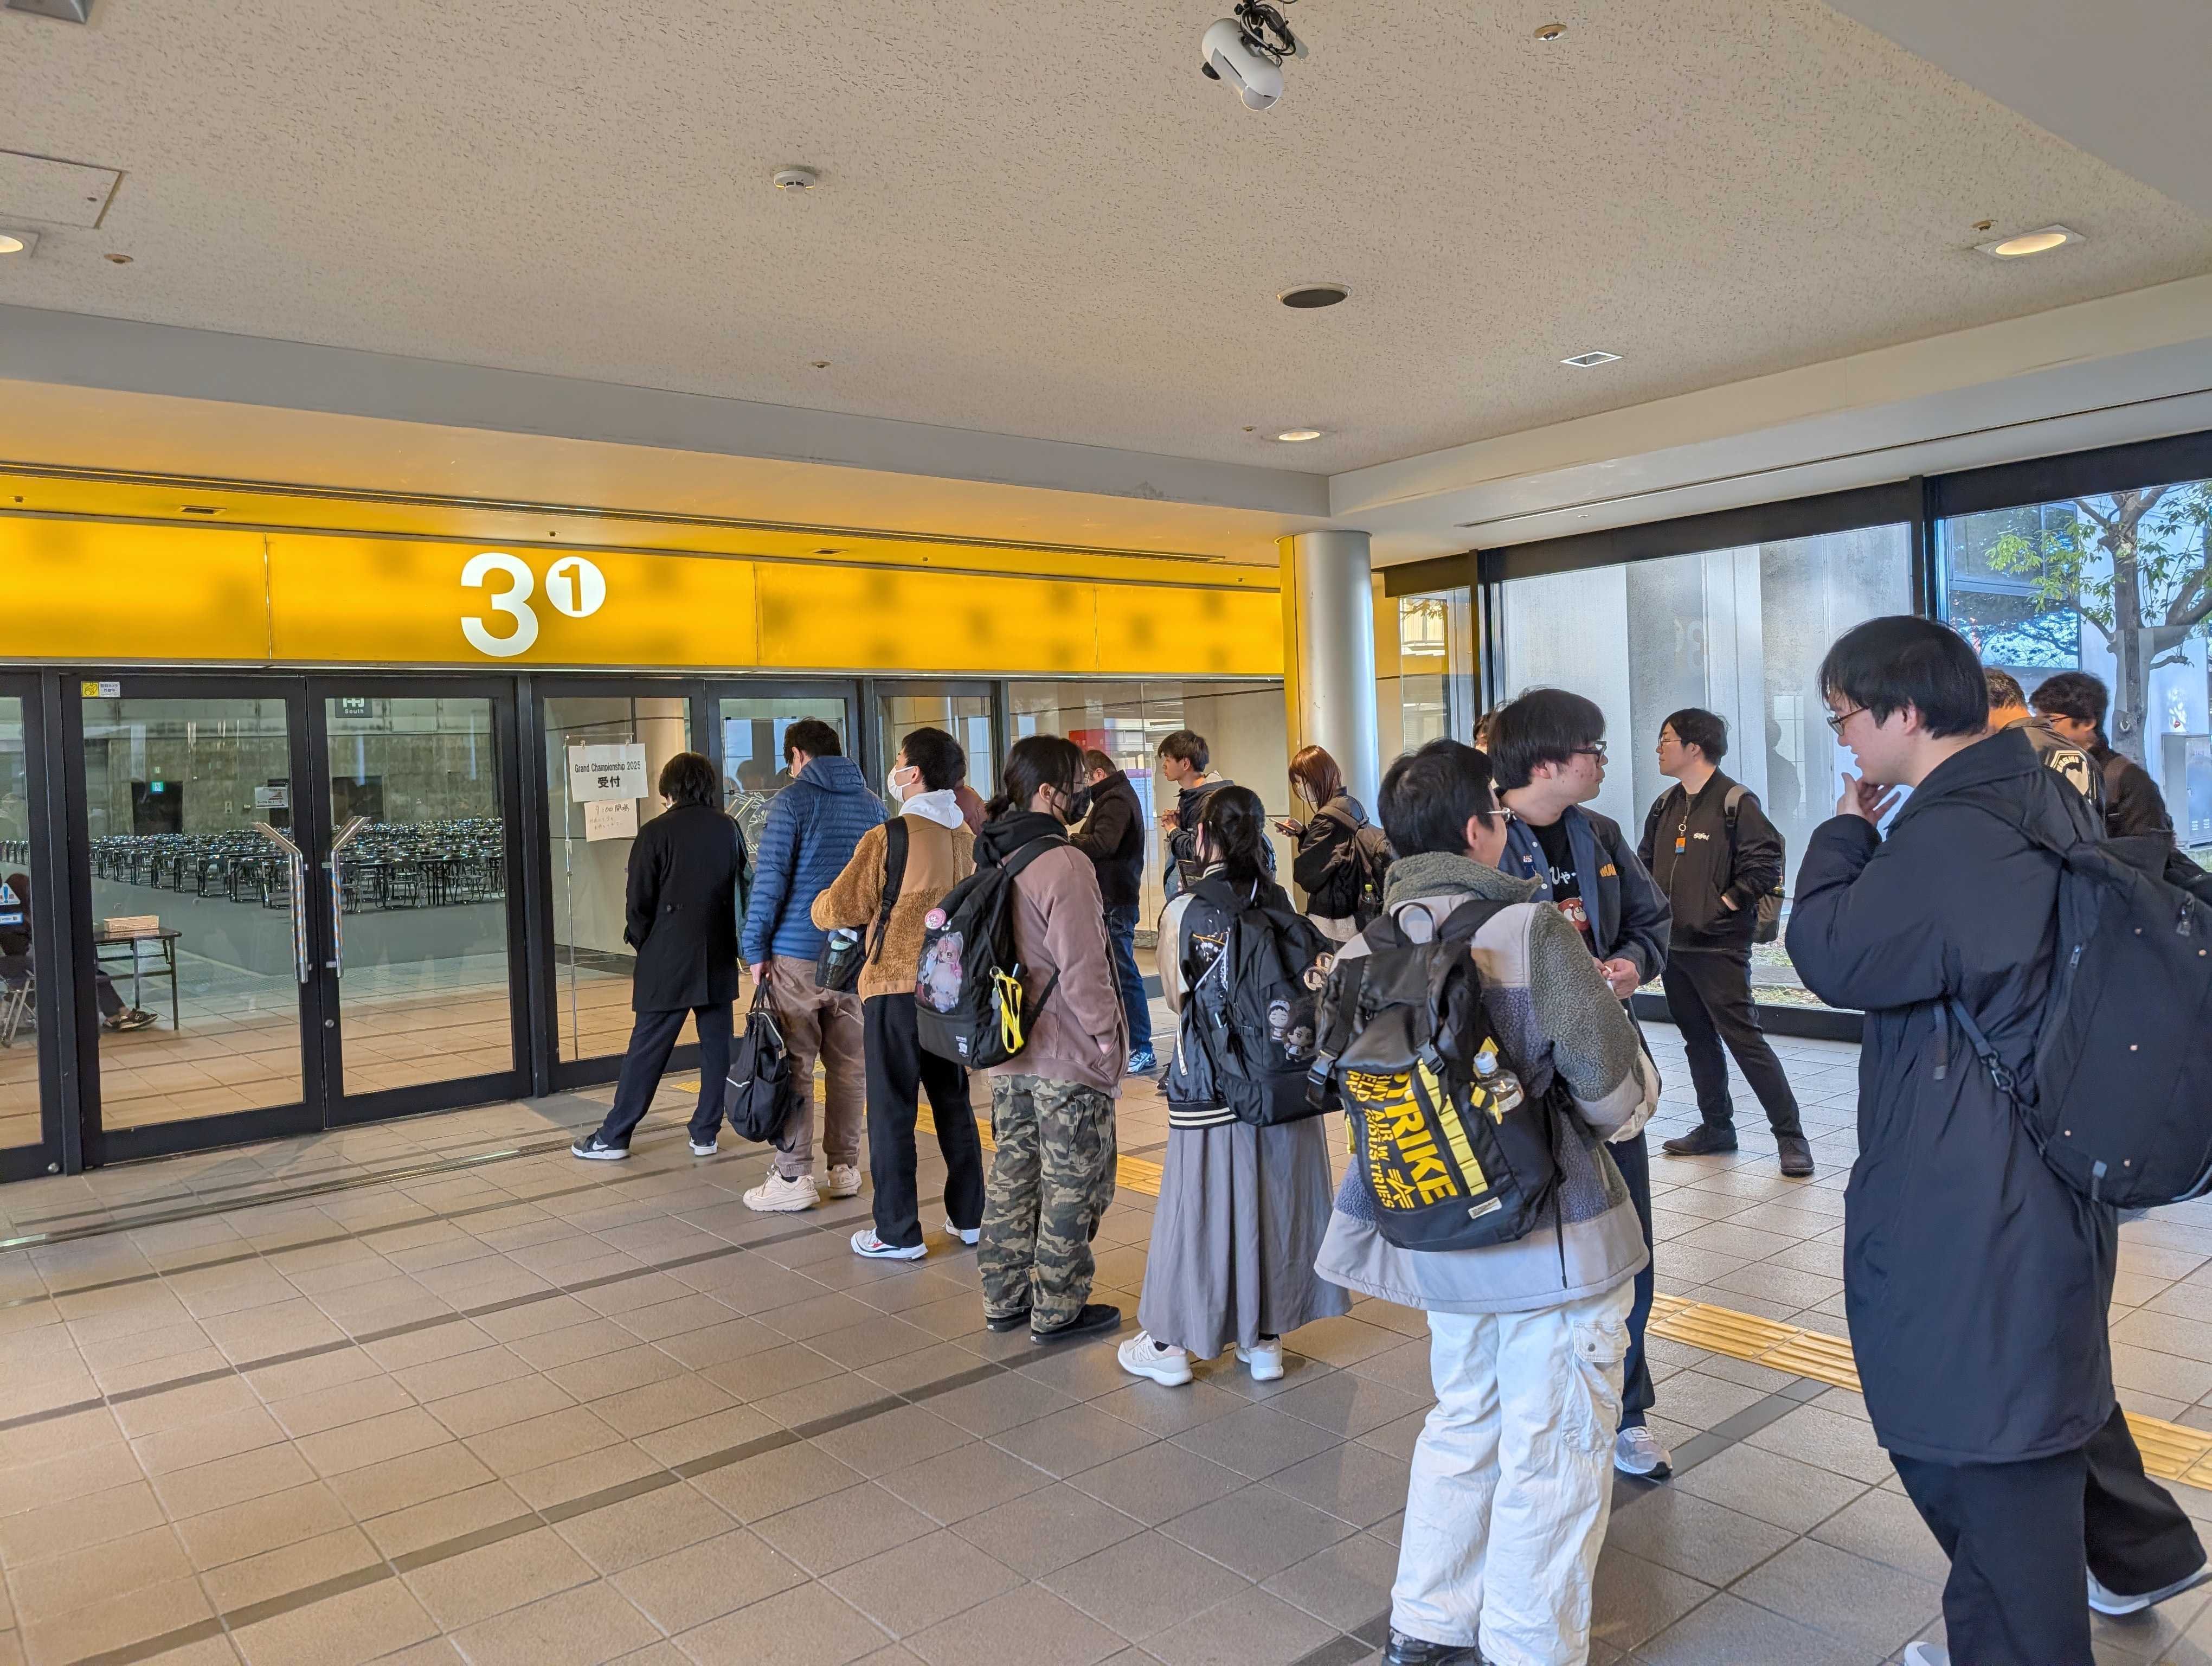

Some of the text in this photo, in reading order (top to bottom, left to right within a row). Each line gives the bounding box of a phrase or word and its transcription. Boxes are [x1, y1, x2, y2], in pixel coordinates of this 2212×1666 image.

[461, 552, 538, 657] 3
[575, 761, 641, 773] Grand Championship 2025
[597, 776, 620, 788] 受付
